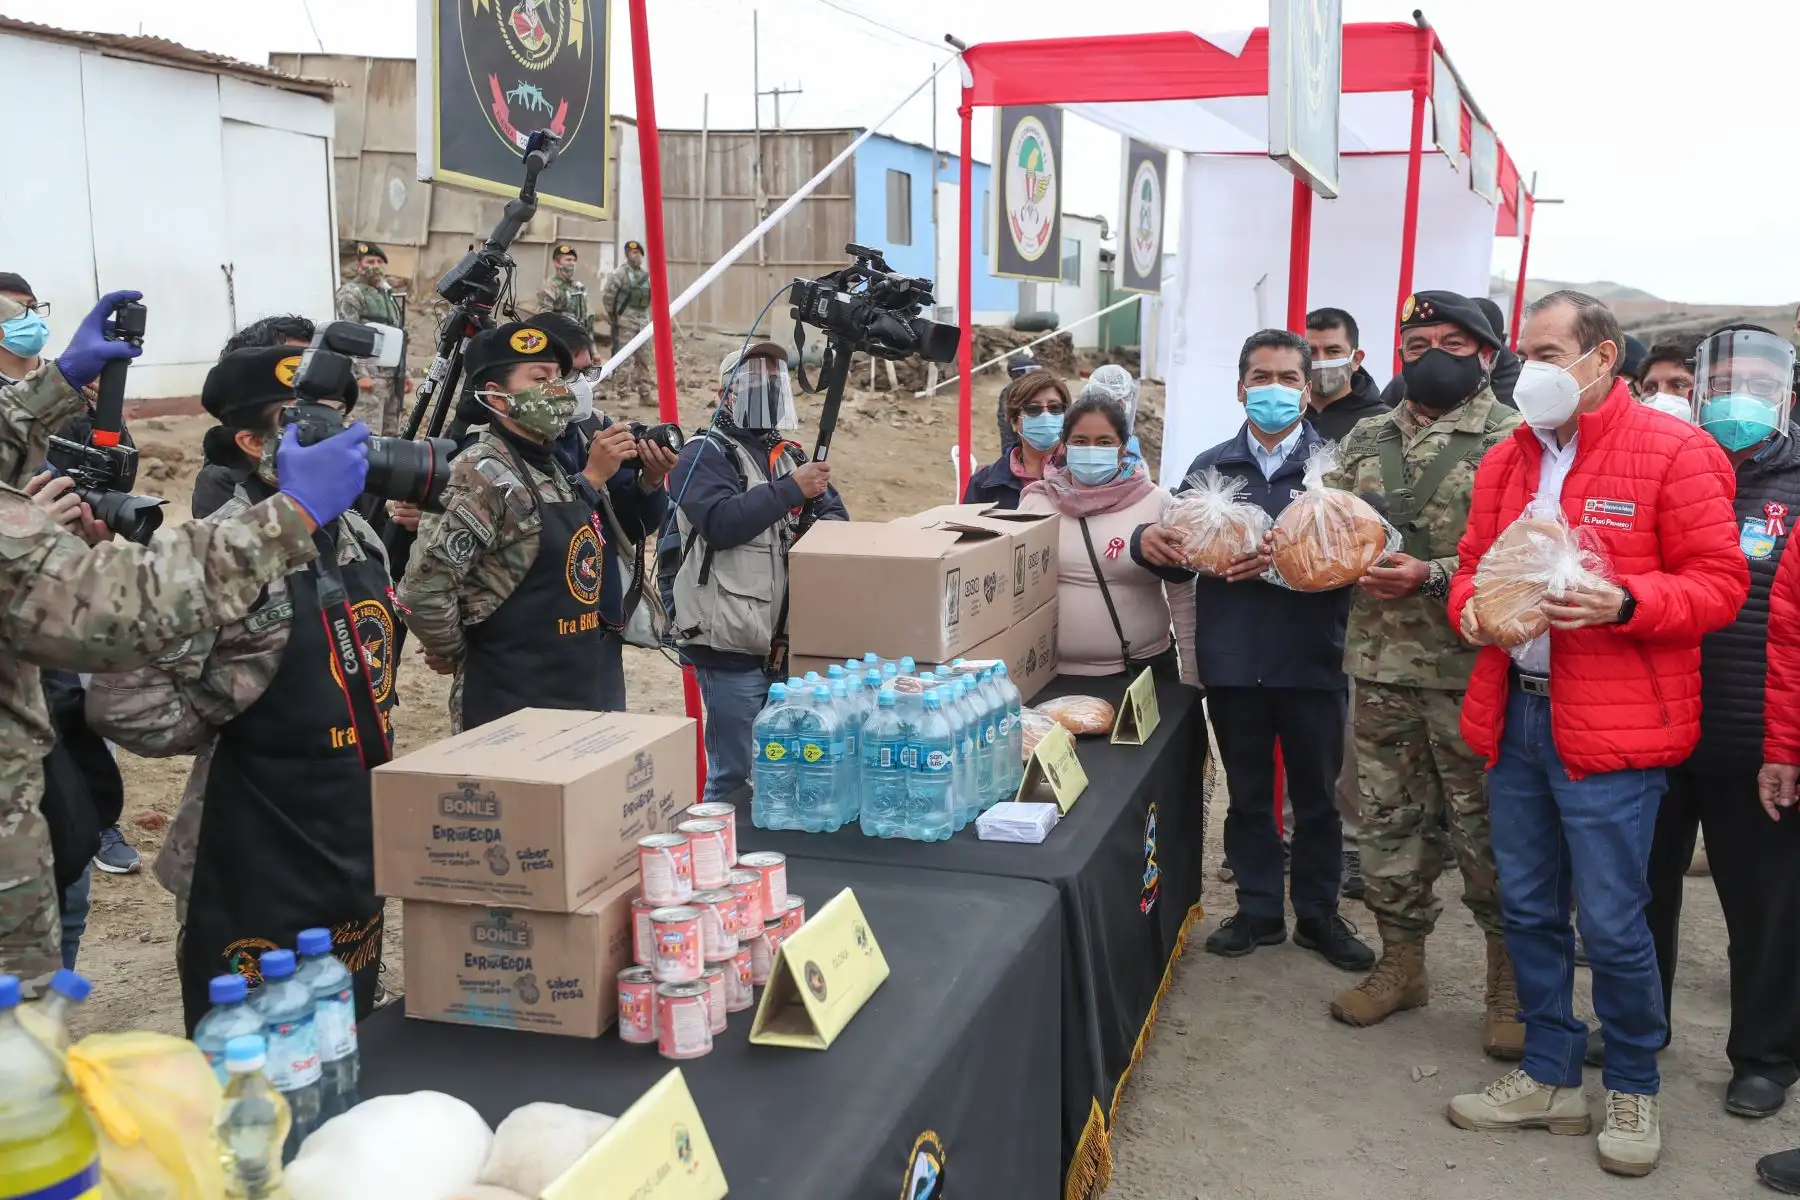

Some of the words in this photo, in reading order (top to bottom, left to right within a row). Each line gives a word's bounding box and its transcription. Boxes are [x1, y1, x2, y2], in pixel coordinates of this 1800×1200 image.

[333, 618, 359, 675] Canon
[521, 860, 554, 873] fresa
[551, 989, 584, 1003] fresa
